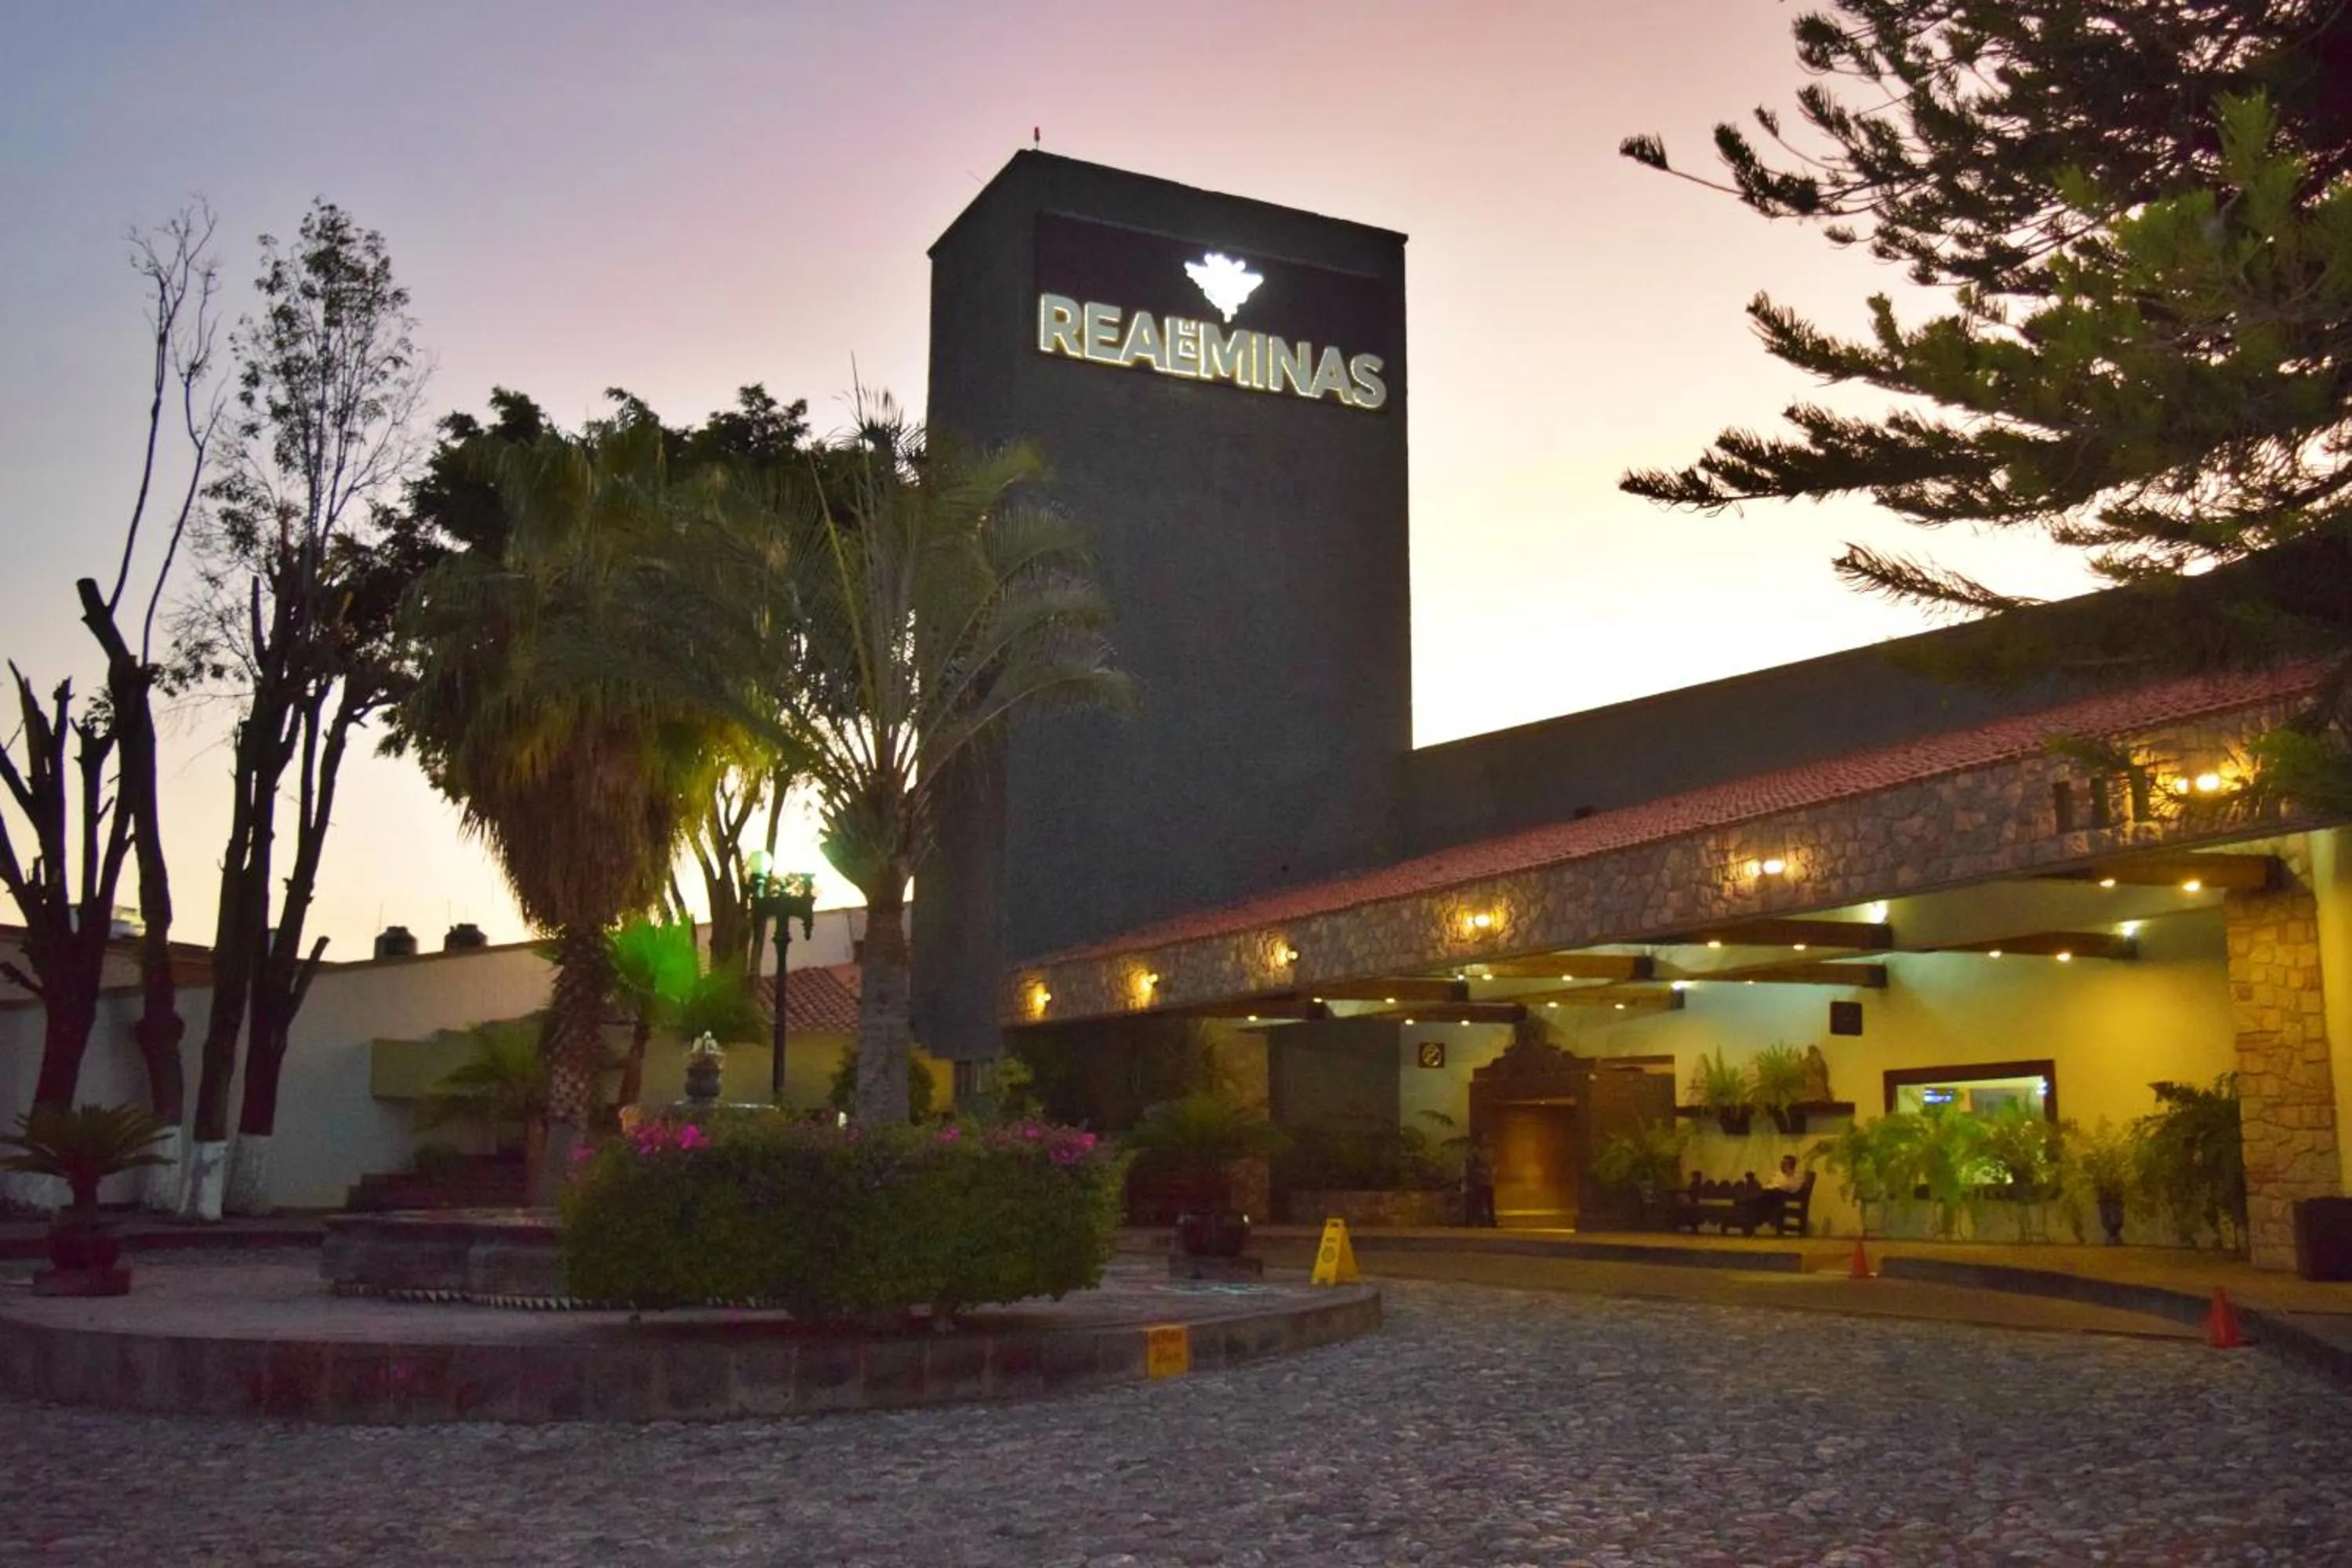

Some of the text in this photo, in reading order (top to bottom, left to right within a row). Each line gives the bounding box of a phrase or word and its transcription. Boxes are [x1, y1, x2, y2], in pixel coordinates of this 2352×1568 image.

[1039, 292, 1387, 409] REAL DE MINAS
